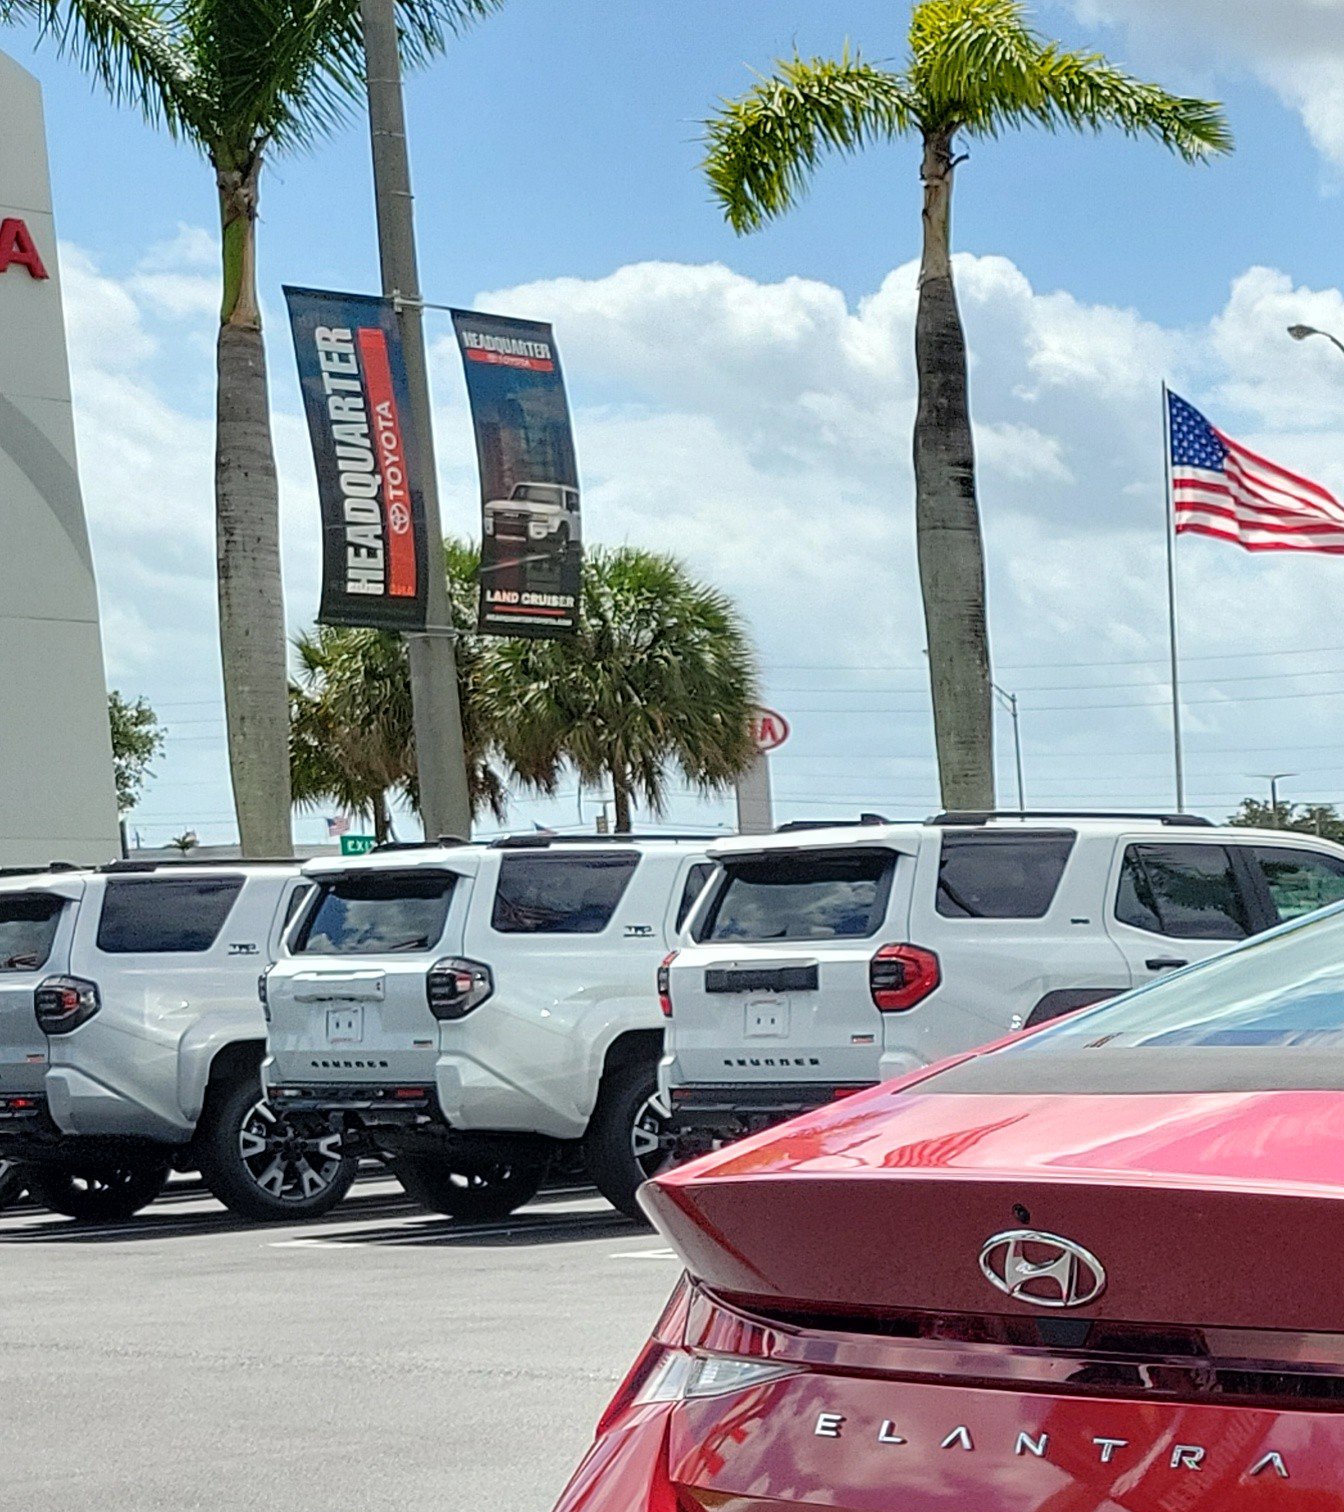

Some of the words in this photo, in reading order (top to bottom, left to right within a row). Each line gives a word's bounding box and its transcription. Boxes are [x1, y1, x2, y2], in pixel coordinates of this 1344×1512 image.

[462, 331, 551, 359] HEADQUARTER
[314, 325, 386, 596] HEADQUARTER
[375, 400, 403, 500] TOYOTA
[486, 589, 520, 603] LAND
[521, 592, 575, 607] CRUISER
[814, 1412, 1290, 1479] ELANTRA
